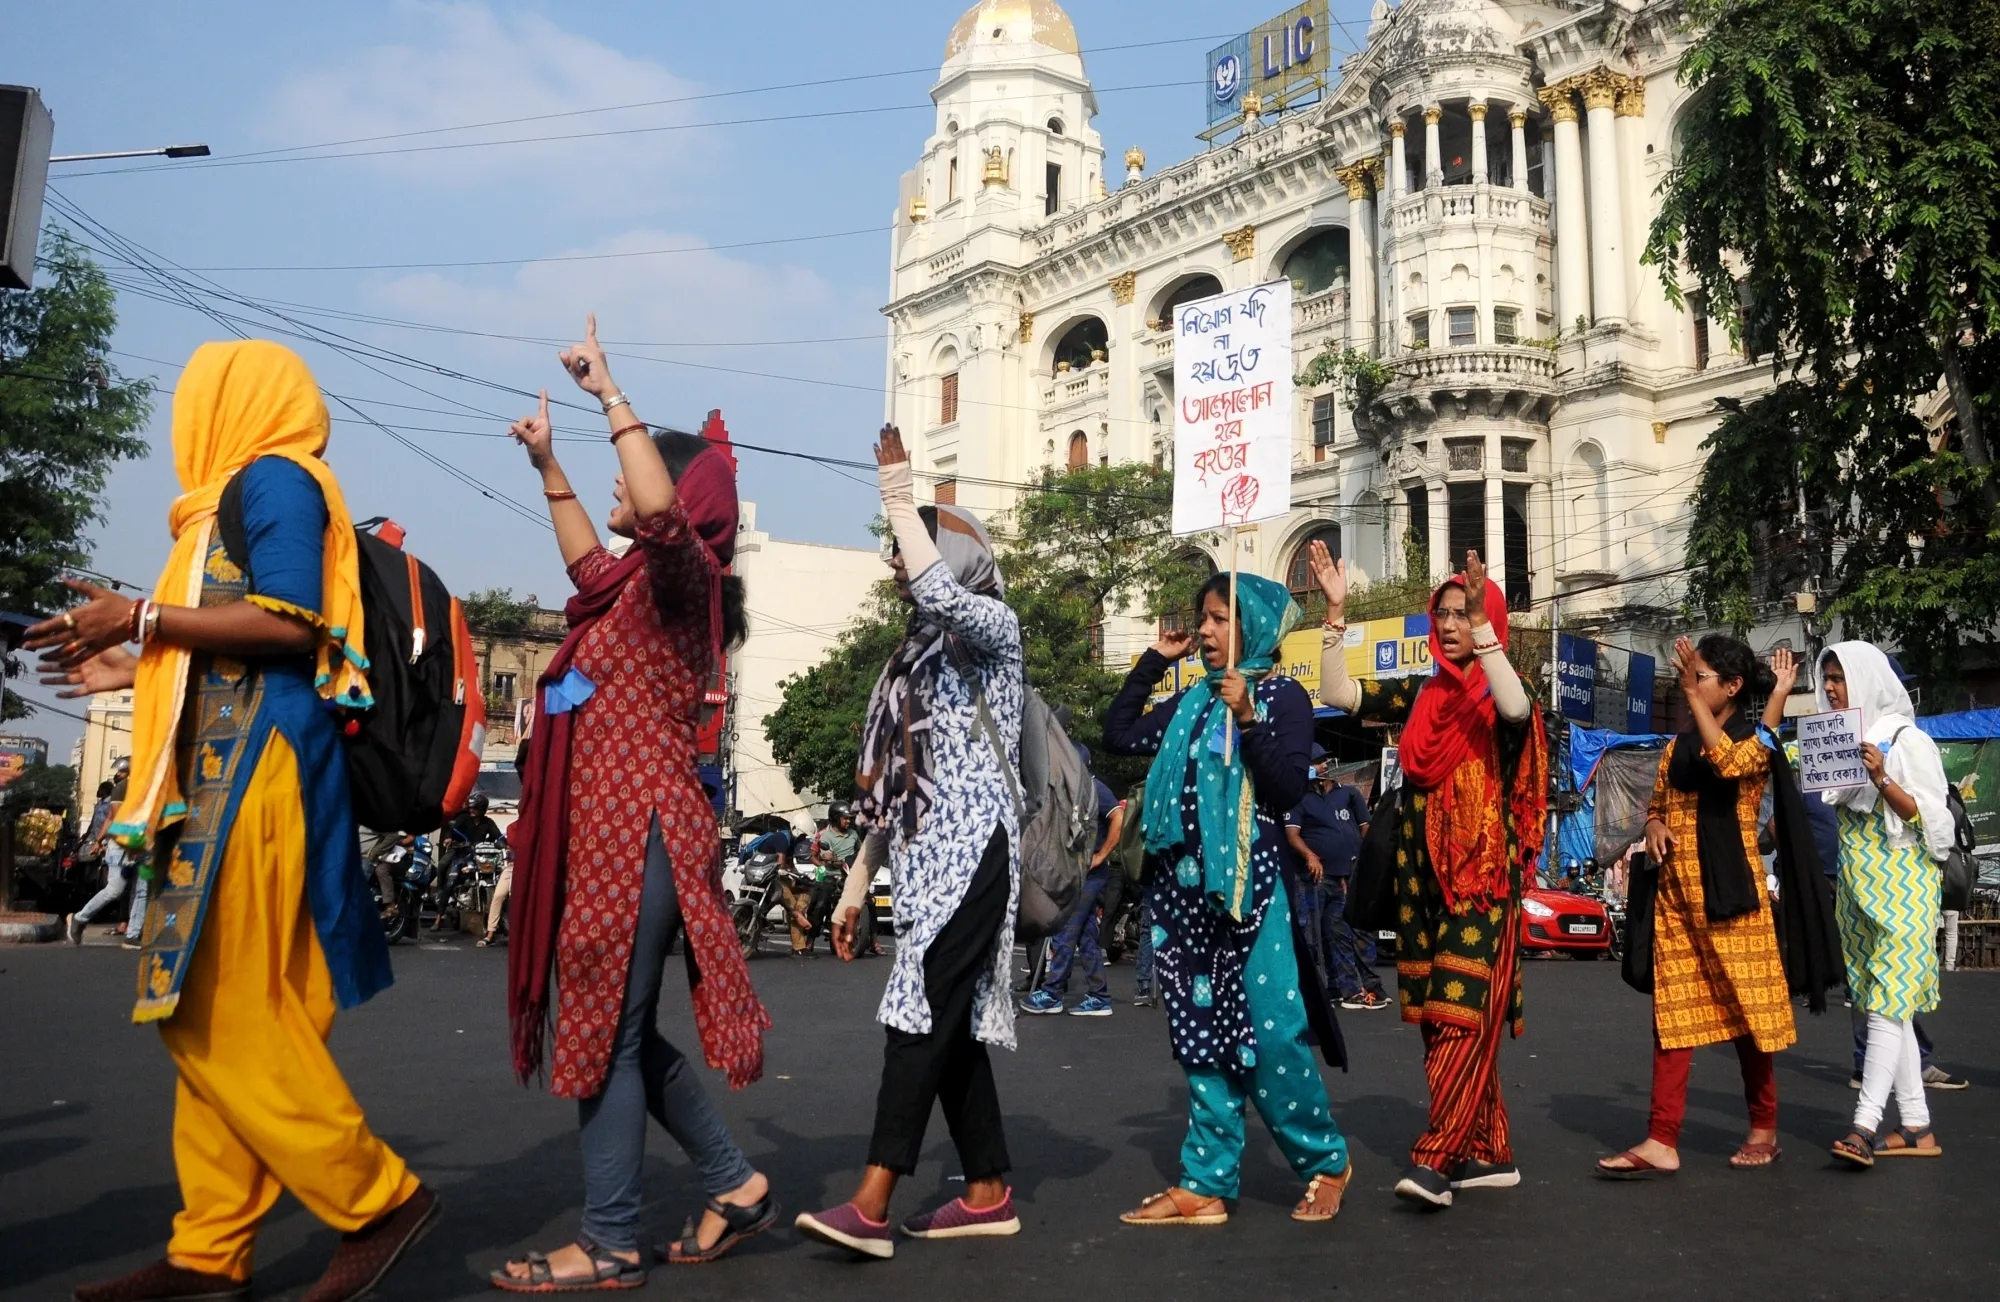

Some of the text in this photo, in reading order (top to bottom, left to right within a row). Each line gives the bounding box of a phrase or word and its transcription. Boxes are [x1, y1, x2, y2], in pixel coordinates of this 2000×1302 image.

[1263, 16, 1314, 79] LIC
[1179, 288, 1275, 337] নিয়োগ যদি
[1213, 333, 1230, 351] না
[1190, 358, 1217, 385] হয়
[1214, 419, 1243, 442] হবে
[1401, 640, 1429, 665] LIC
[1568, 663, 1594, 680] saath
[1632, 698, 1647, 715] bhi
[1827, 713, 1845, 731] দাবি
[1822, 730, 1855, 748] অধিকার
[1802, 752, 1817, 768] তবু
[1816, 749, 1835, 764] কেন
[1832, 766, 1858, 781] বেকার
